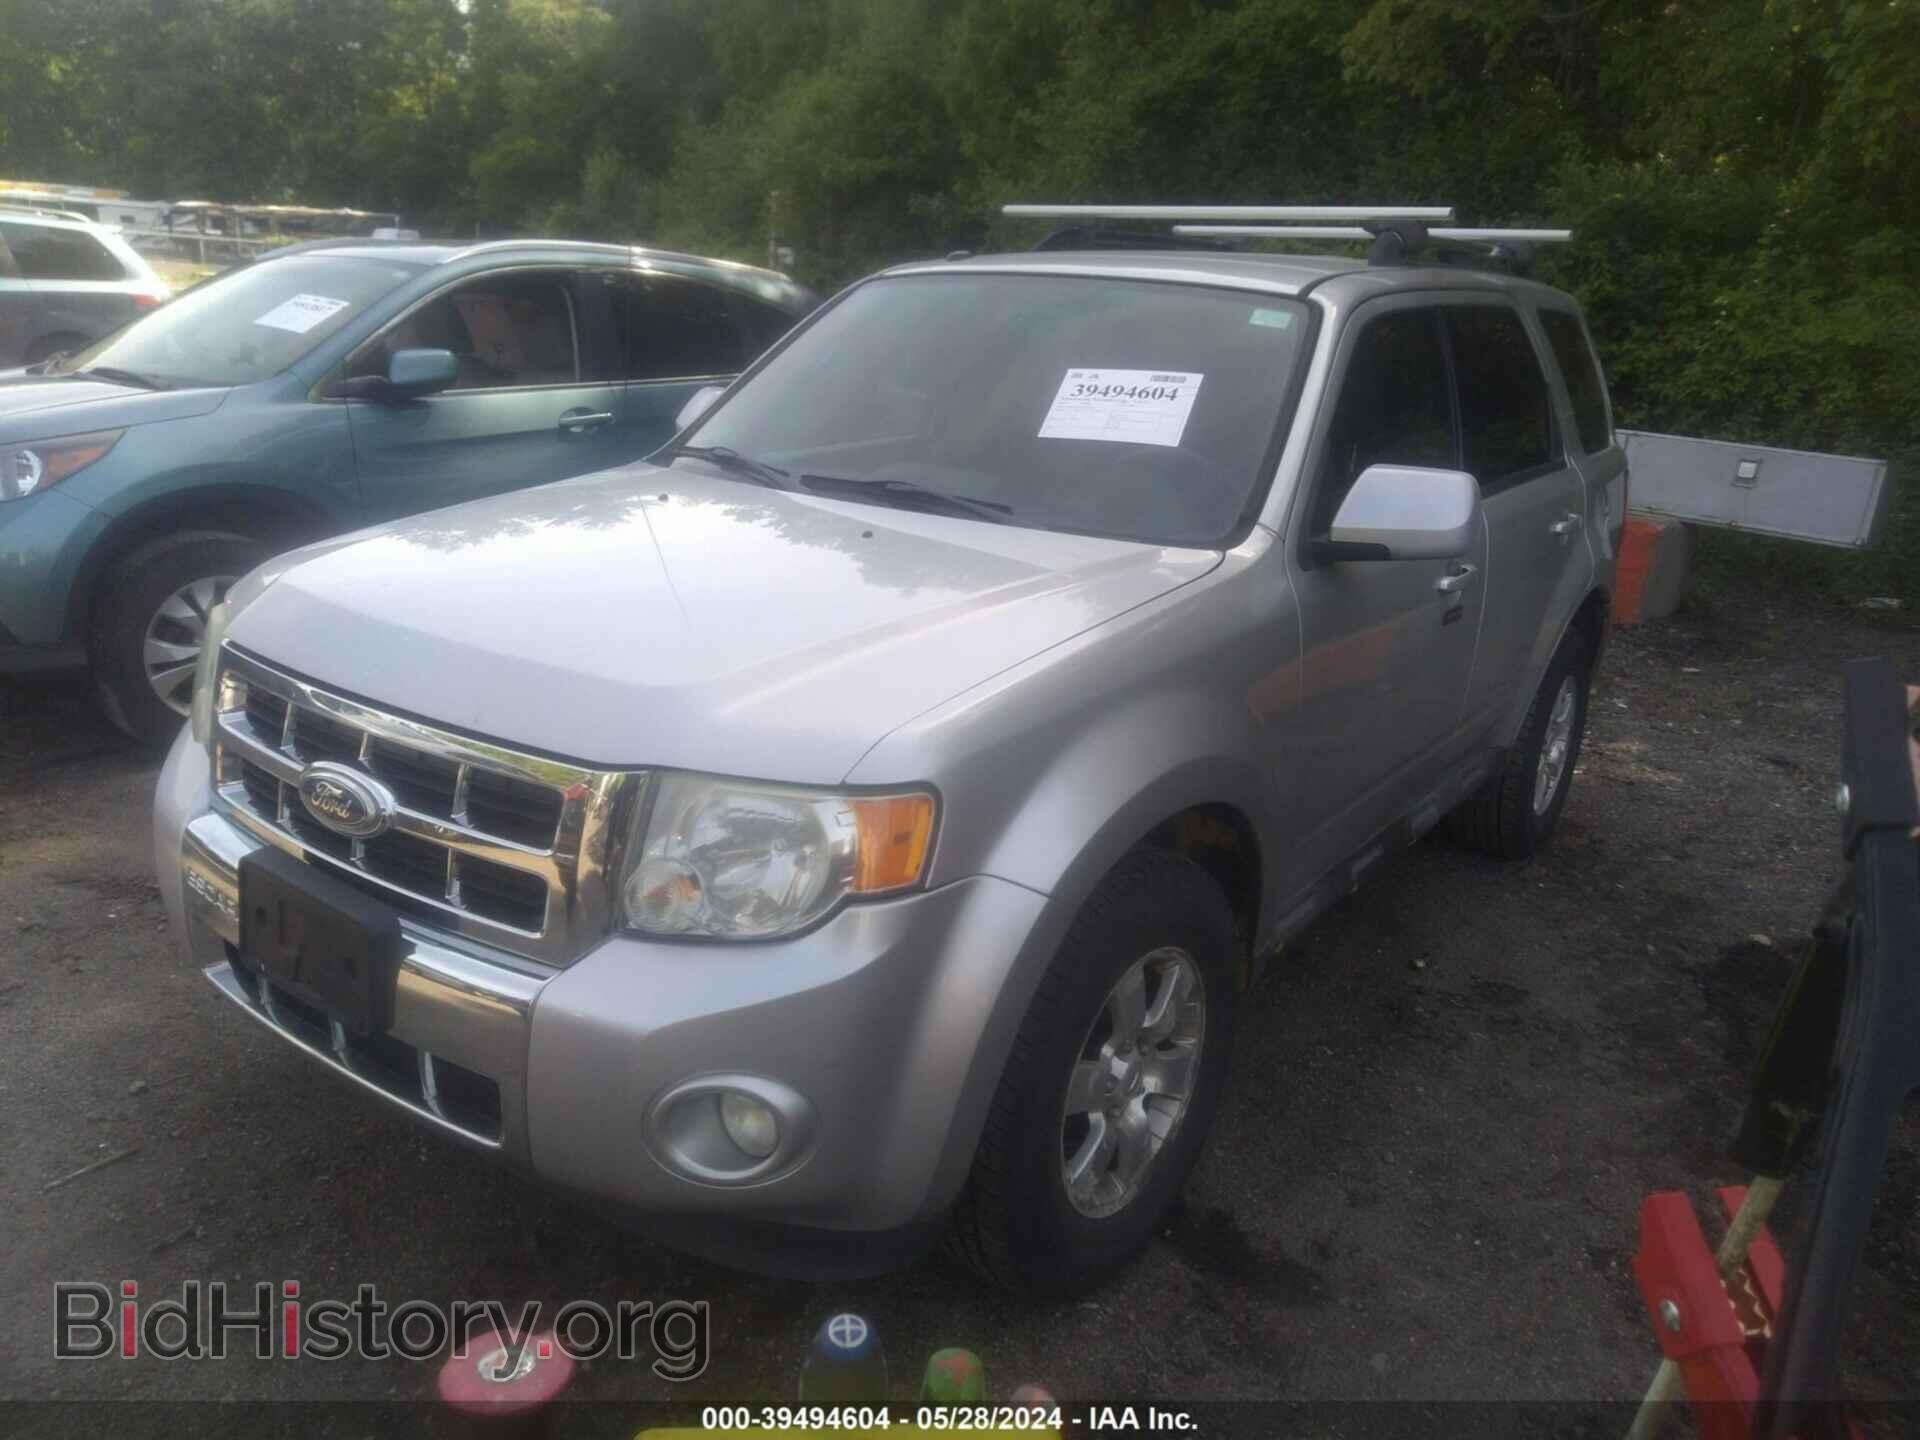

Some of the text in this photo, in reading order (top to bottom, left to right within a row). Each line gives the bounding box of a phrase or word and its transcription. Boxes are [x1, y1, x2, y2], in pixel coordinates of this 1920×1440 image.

[1070, 384, 1179, 401] 39494604
[311, 781, 352, 819] Ford
[187, 870, 239, 920] ESCAP
